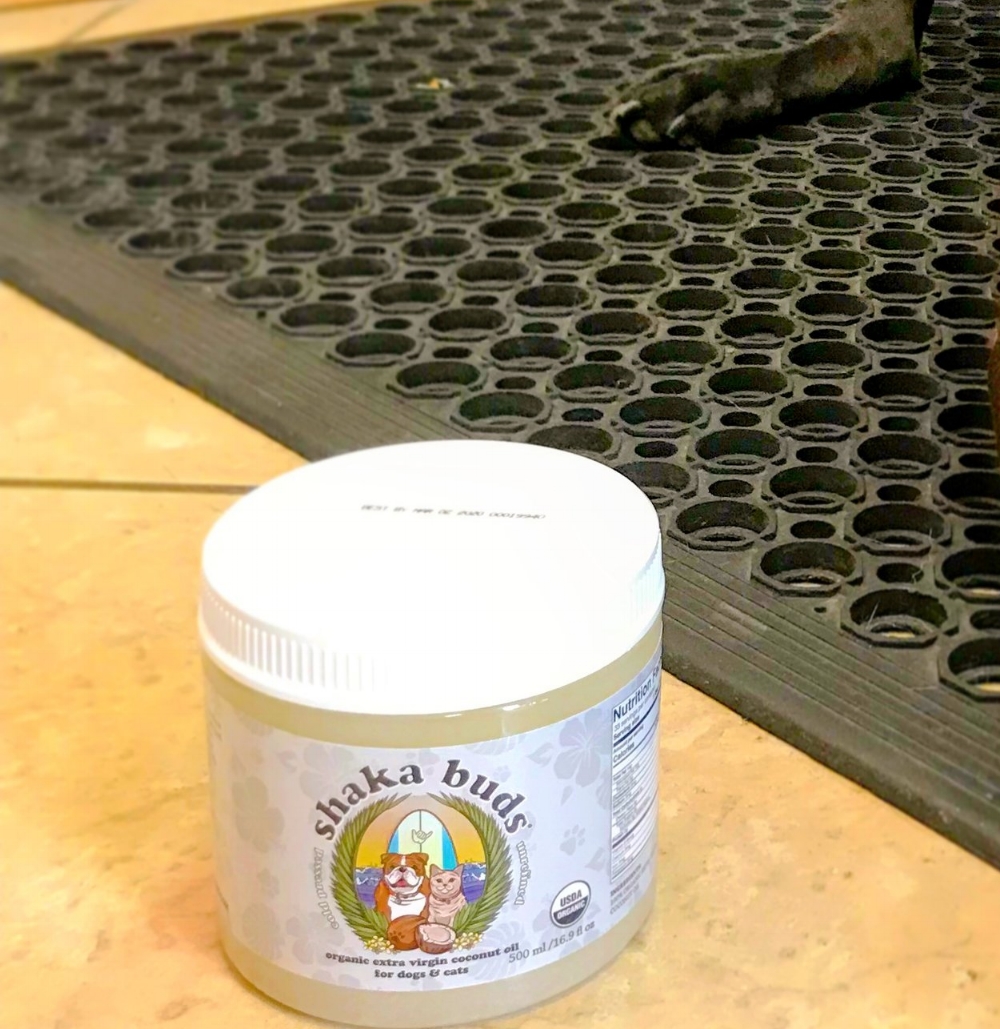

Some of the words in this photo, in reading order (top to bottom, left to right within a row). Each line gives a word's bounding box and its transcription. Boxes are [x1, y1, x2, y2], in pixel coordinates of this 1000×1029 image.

[613, 677, 652, 722] Nutrition
[613, 722, 632, 740] Serving
[613, 742, 635, 763] Calories
[314, 763, 425, 841] shaka
[441, 759, 528, 834] buds
[514, 840, 531, 906] unrefined
[556, 899, 587, 920] ORGANIC
[560, 889, 583, 907] USDA
[508, 949, 530, 963] 500
[576, 924, 584, 936] fl
[584, 921, 595, 932] oz
[325, 951, 370, 966] organic
[372, 957, 406, 967] extra
[409, 956, 448, 968] virgin
[451, 948, 501, 964] coconut
[503, 942, 520, 954] oil
[374, 968, 394, 978] for
[397, 969, 426, 980] dogs
[428, 969, 442, 978] &
[443, 965, 469, 977] cats
